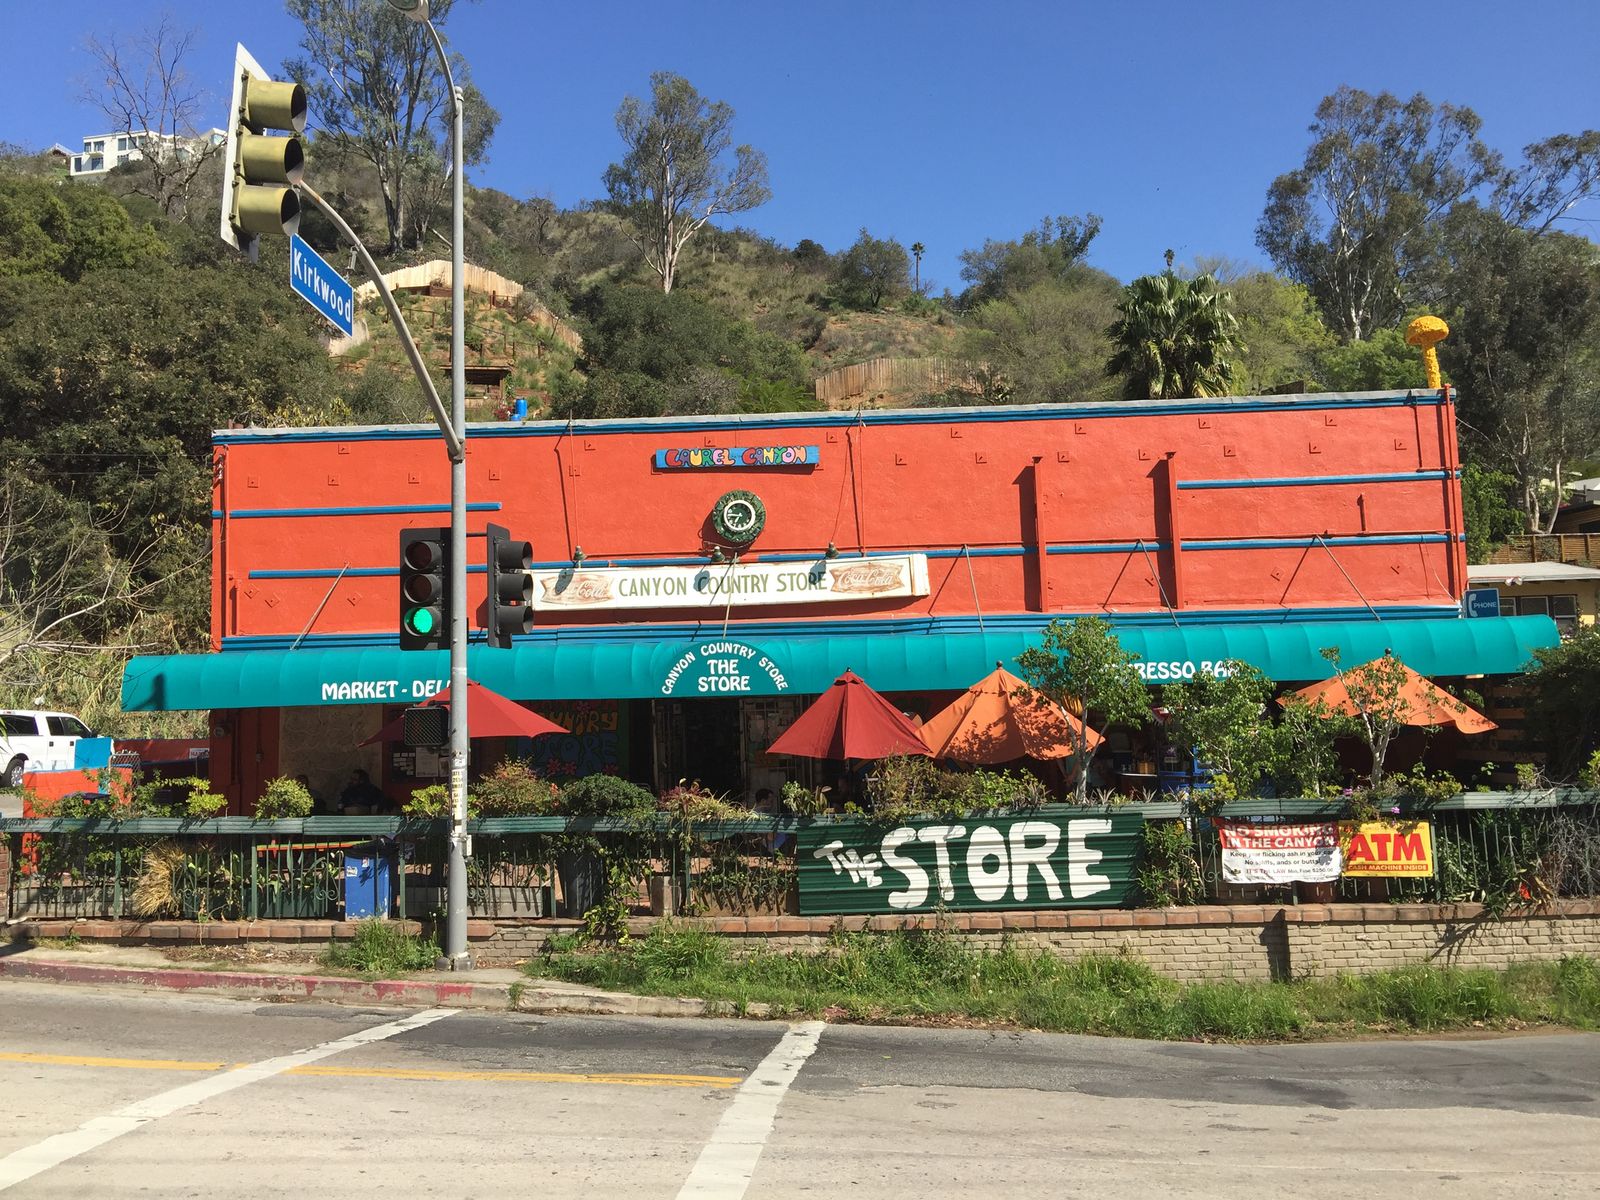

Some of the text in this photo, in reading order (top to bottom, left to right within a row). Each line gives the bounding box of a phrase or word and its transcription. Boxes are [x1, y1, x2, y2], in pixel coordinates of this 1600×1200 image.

[293, 247, 351, 323] Kirkwood
[665, 446, 807, 467] LAUREL CANYON
[618, 571, 828, 597] CANYON COUNTRY STORE
[838, 567, 894, 587] Coca-Cola
[1473, 601, 1497, 609] PHONE
[661, 642, 789, 695] CANYON COUNTRY STORE
[698, 659, 751, 692] THE STORE
[321, 680, 399, 701] MARKET
[1223, 823, 1334, 837] NO SMOKING
[1227, 837, 1334, 848] IN THE CANYON
[1348, 832, 1427, 861] ATM
[814, 819, 1112, 909] THE STORE
[1230, 851, 1247, 859] Keep
